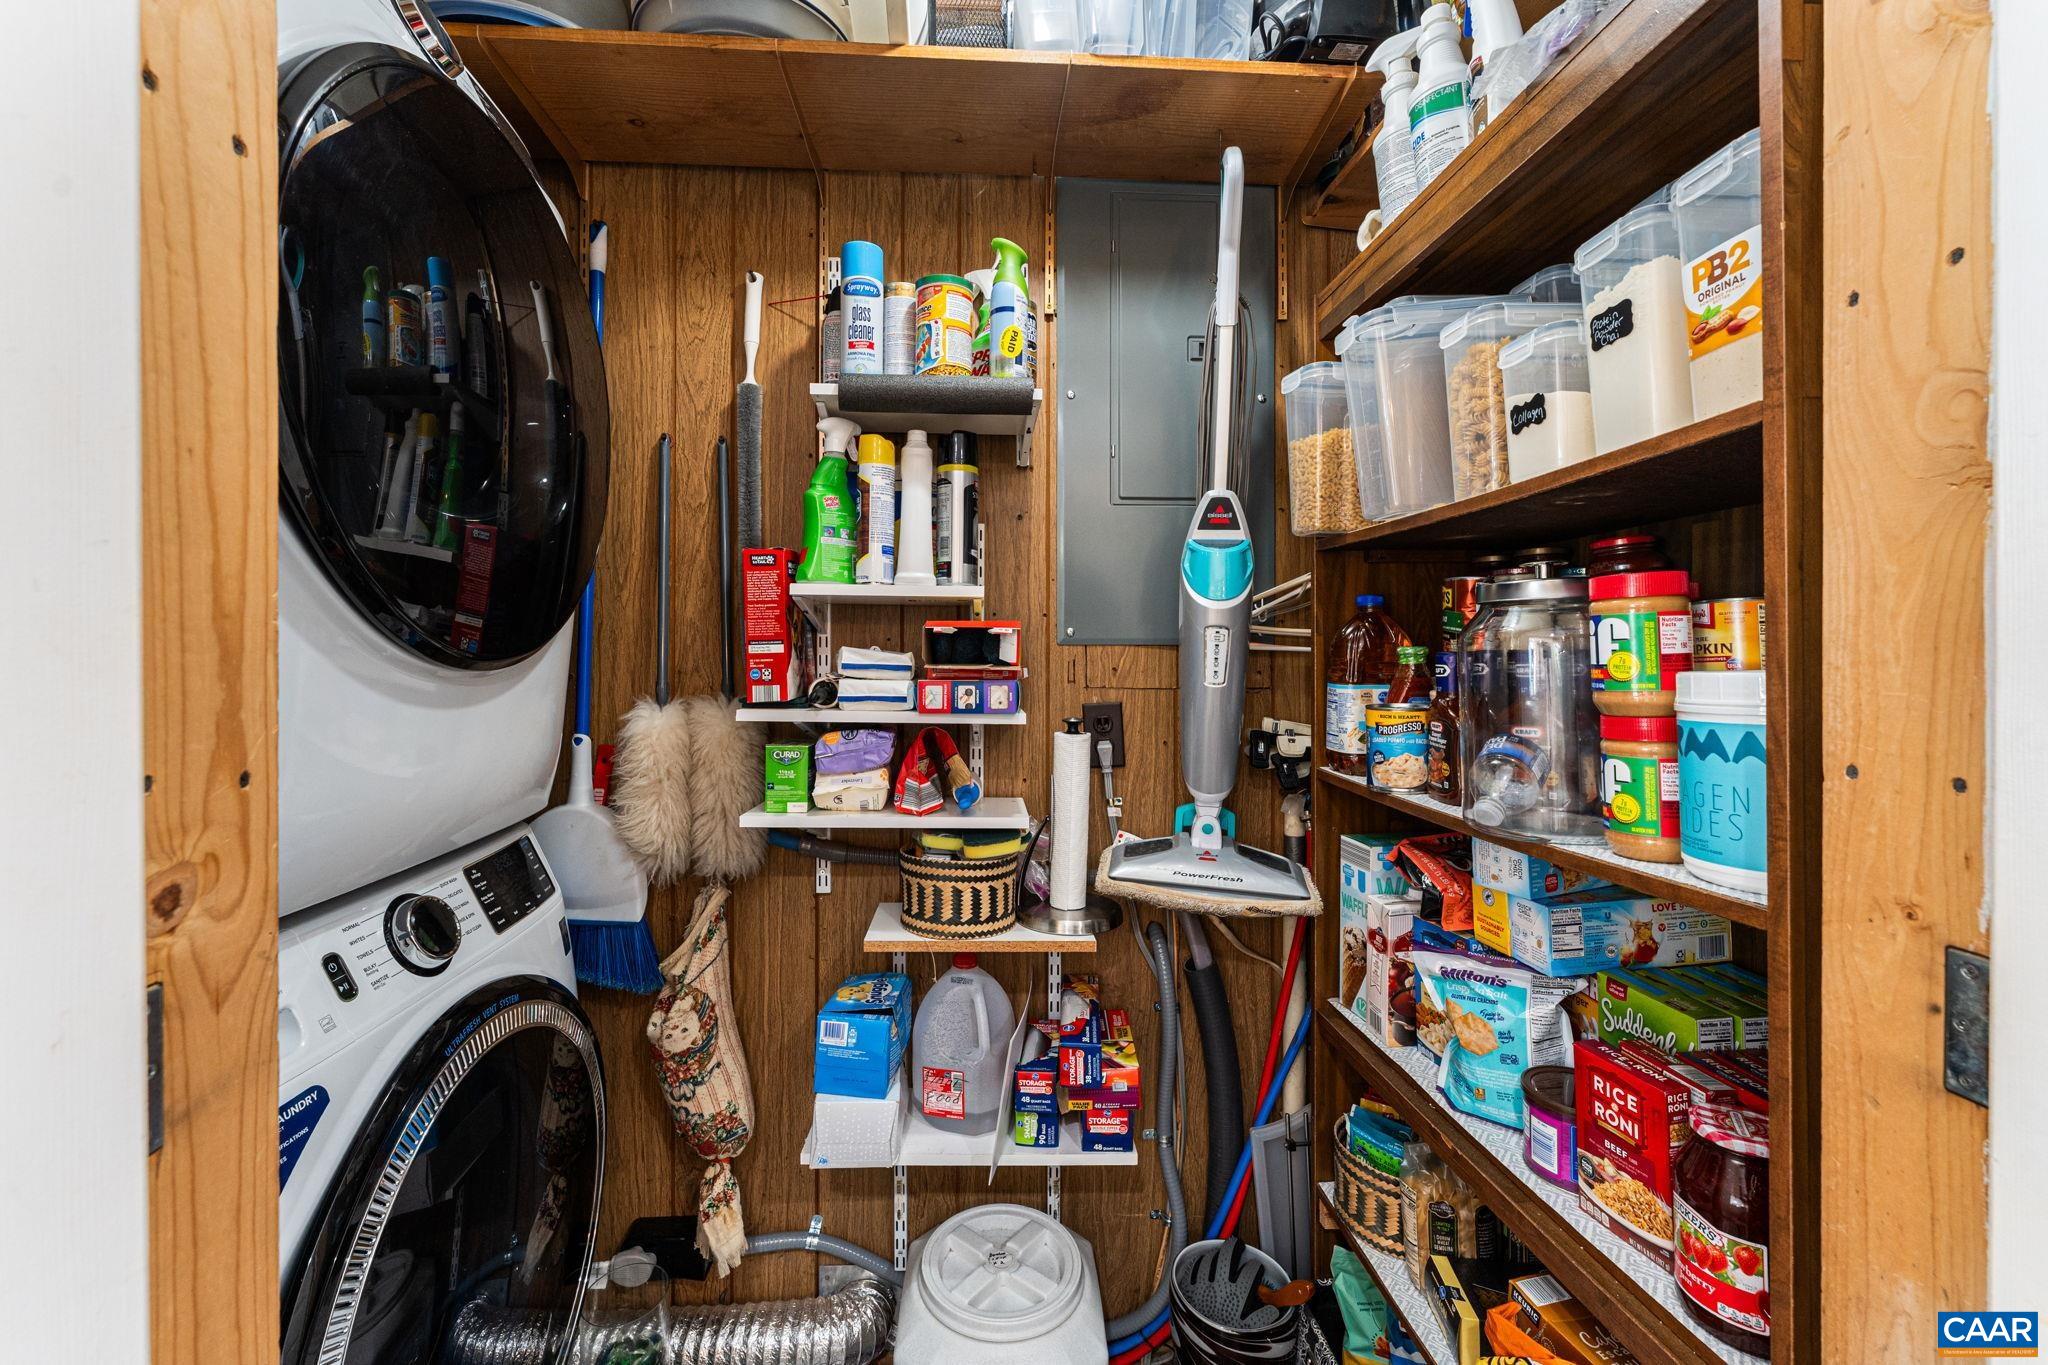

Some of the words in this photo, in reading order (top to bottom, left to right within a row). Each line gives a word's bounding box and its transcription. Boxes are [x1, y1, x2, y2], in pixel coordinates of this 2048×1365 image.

[1692, 239, 1751, 294] PB2
[847, 284, 878, 294] Sprayway
[1698, 273, 1746, 302] ORIGINAL
[852, 304, 872, 323] glass
[1592, 312, 1619, 331] Protein
[848, 324, 874, 340] cleaner
[1594, 317, 1623, 342] Powder
[1008, 330, 1018, 353] PAID
[1600, 330, 1620, 346] Chai
[1513, 406, 1544, 427] Collagen
[1378, 722, 1422, 735] PROGRESSO
[773, 750, 800, 759] CURAD
[1172, 870, 1244, 882] PowerFresh
[1651, 902, 1677, 912] LOVE
[342, 922, 360, 933] NORMAL
[349, 935, 366, 946] WHITES
[356, 949, 374, 960] TOWELS
[363, 962, 377, 973] BULKY
[370, 974, 390, 988] SANITIZE
[1440, 966, 1508, 988] Milton's
[1446, 983, 1470, 995] Crispy
[1476, 997, 1499, 1006] CRACKERS
[444, 1016, 482, 1058] ULTRAFRESH
[482, 1002, 499, 1019] VENT
[499, 994, 520, 1009] SYSTEM
[1598, 1046, 1628, 1062] RICE
[1633, 1064, 1668, 1083] RONI
[1086, 1074, 1092, 1084] 38
[926, 1090, 962, 1106] Food
[1592, 1074, 1638, 1114] RICE
[1667, 1092, 1688, 1104] RICE
[279, 1091, 319, 1124] AUNDRY
[1668, 1102, 1689, 1114] RONI
[1594, 1100, 1639, 1140] RONI
[1038, 1134, 1046, 1144] 90
[1604, 1139, 1628, 1158] BEEF
[1513, 1289, 1540, 1323] KEURIG
